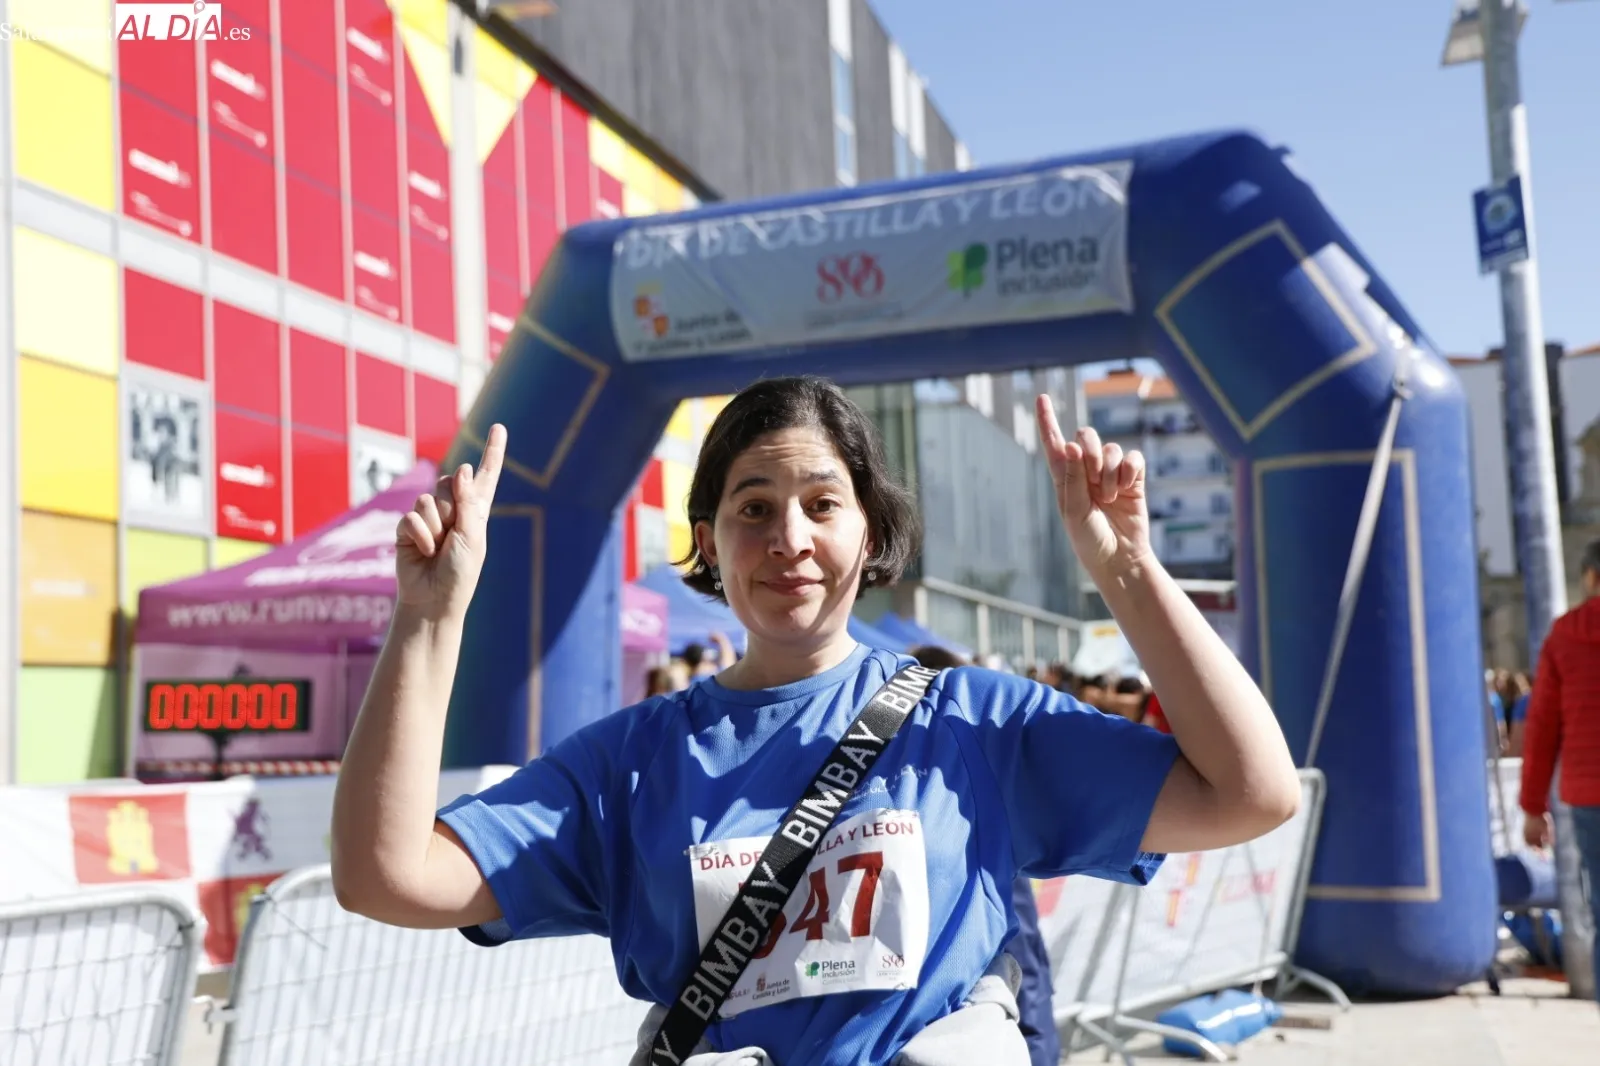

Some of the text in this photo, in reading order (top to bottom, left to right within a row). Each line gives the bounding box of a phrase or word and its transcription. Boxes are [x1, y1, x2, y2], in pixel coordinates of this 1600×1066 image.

[755, 200, 943, 251] CASTILLA
[950, 191, 981, 224] Y
[996, 236, 1099, 272] Plena
[149, 683, 298, 730] 000000
[781, 720, 886, 849] BIMBAY
[700, 850, 735, 871] DÍA
[847, 827, 857, 841] Y
[679, 861, 790, 1022] BIMBAY
[821, 960, 855, 971] Plena
